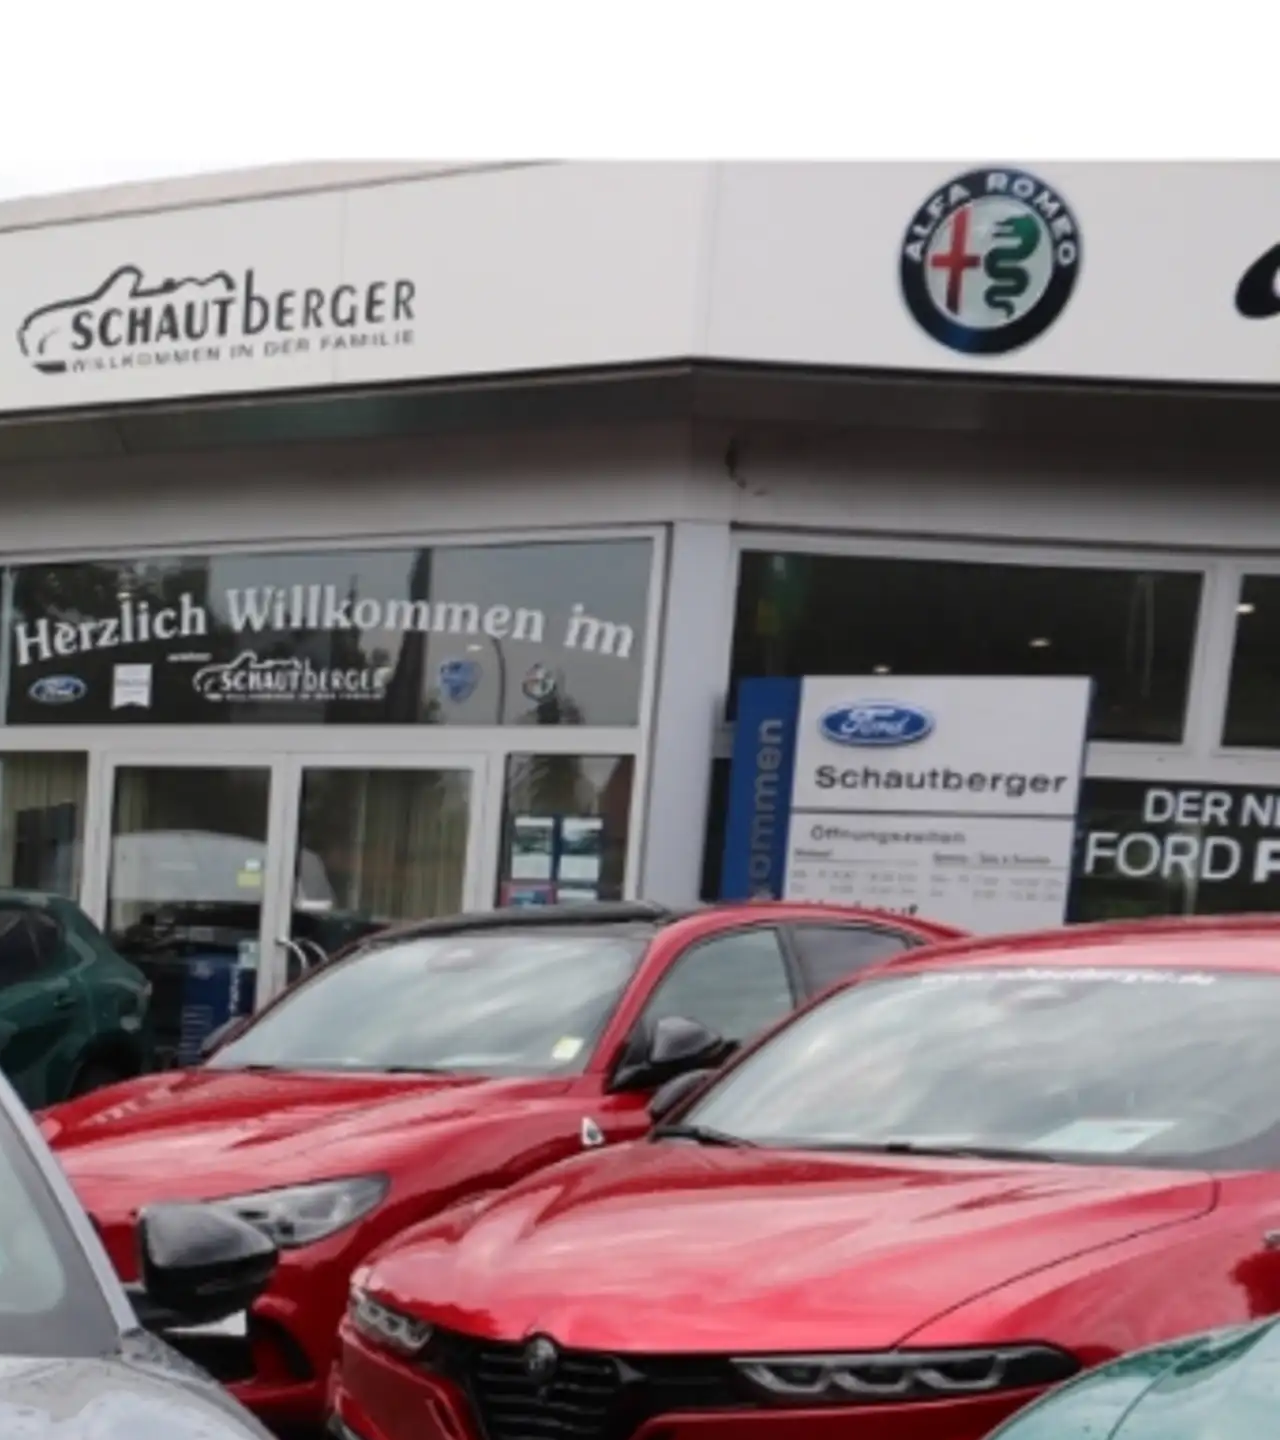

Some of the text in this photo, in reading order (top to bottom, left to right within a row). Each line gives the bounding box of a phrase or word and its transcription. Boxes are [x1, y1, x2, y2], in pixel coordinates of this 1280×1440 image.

[904, 172, 1078, 266] ALFA ROMEO
[71, 329, 416, 373] WILLKOMMEN IN DER FAMILIE
[14, 584, 635, 666] Herzlich Willkommen im
[814, 764, 1068, 798] Schautberger
[1143, 788, 1280, 831] DER N
[1083, 830, 1242, 884] FORD
